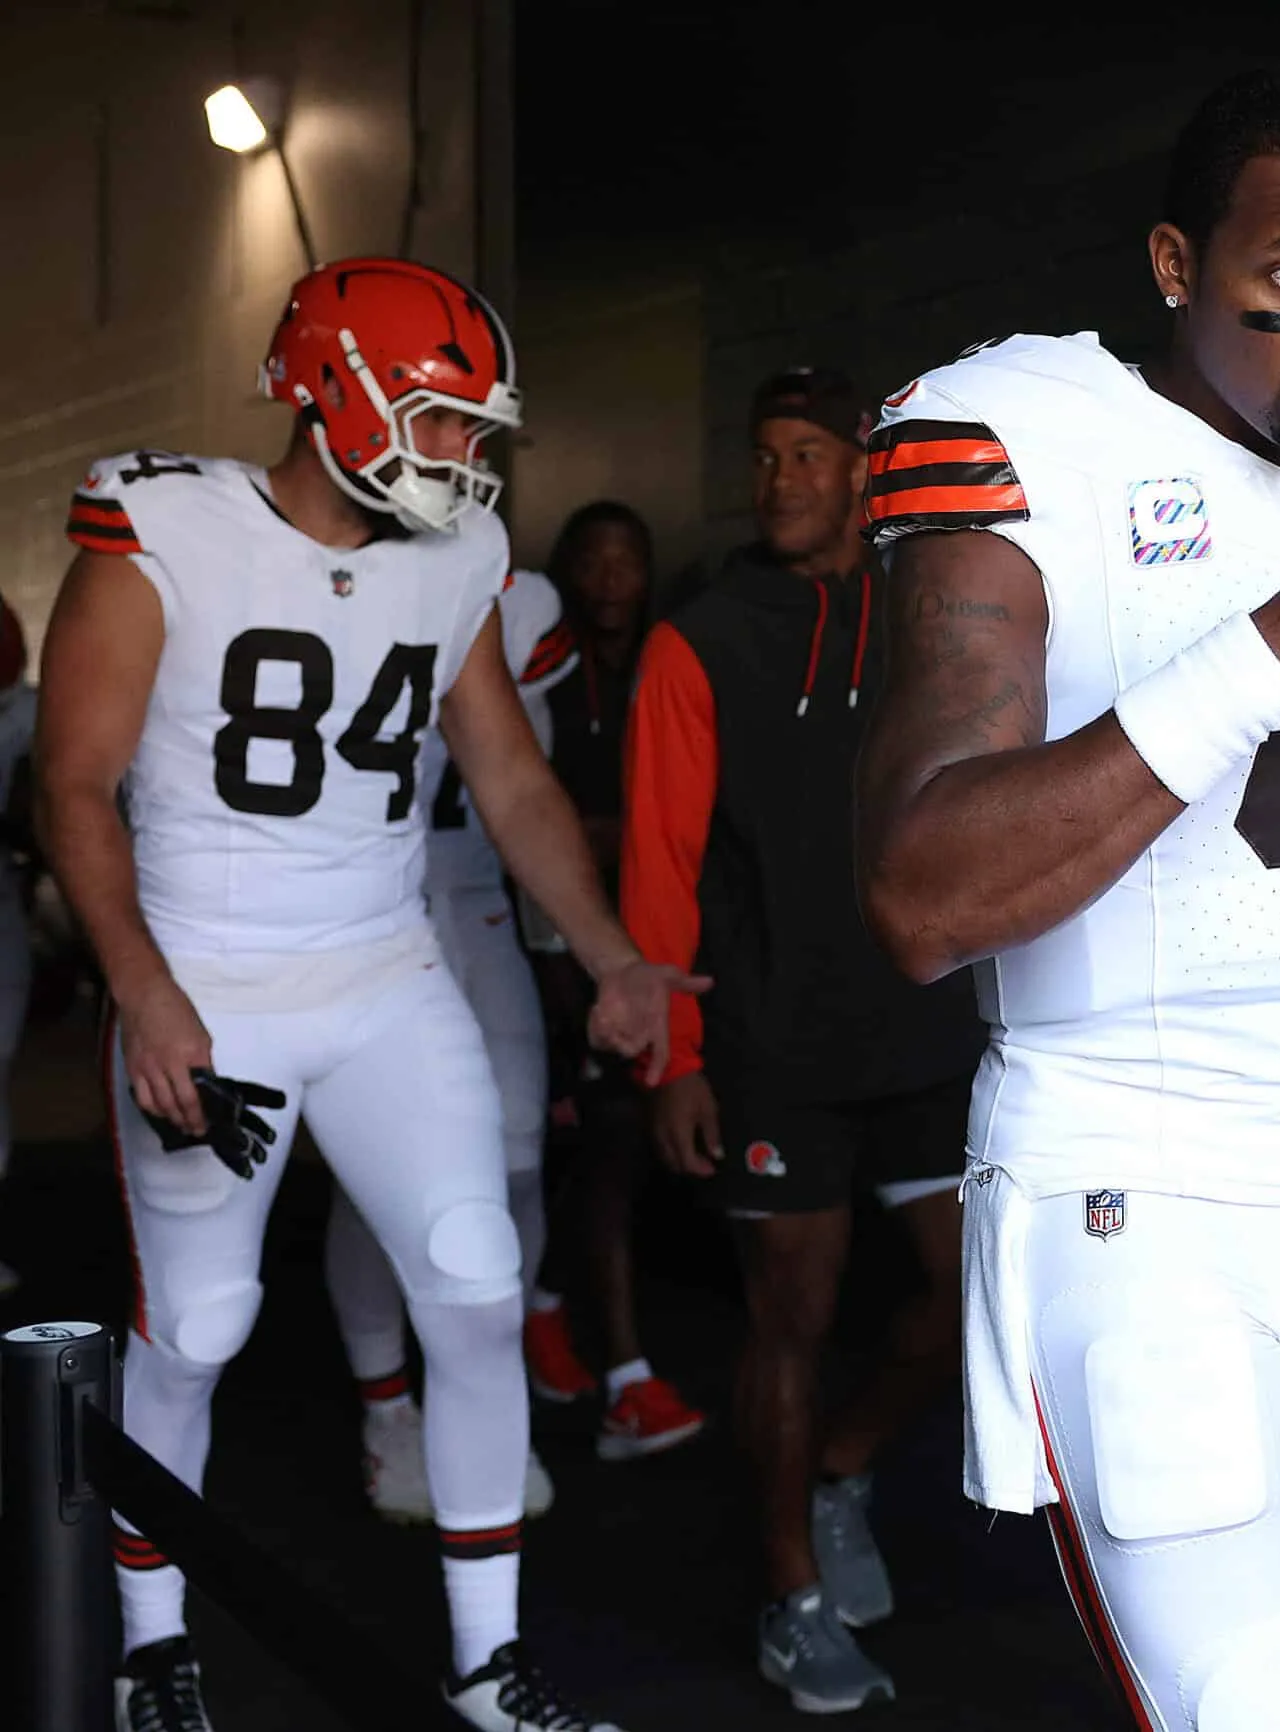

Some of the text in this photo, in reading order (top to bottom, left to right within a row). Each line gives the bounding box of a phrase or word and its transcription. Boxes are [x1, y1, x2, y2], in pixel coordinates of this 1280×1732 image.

[1134, 483, 1205, 542] C
[213, 628, 438, 824] 84
[1089, 1208, 1121, 1231] NFL
